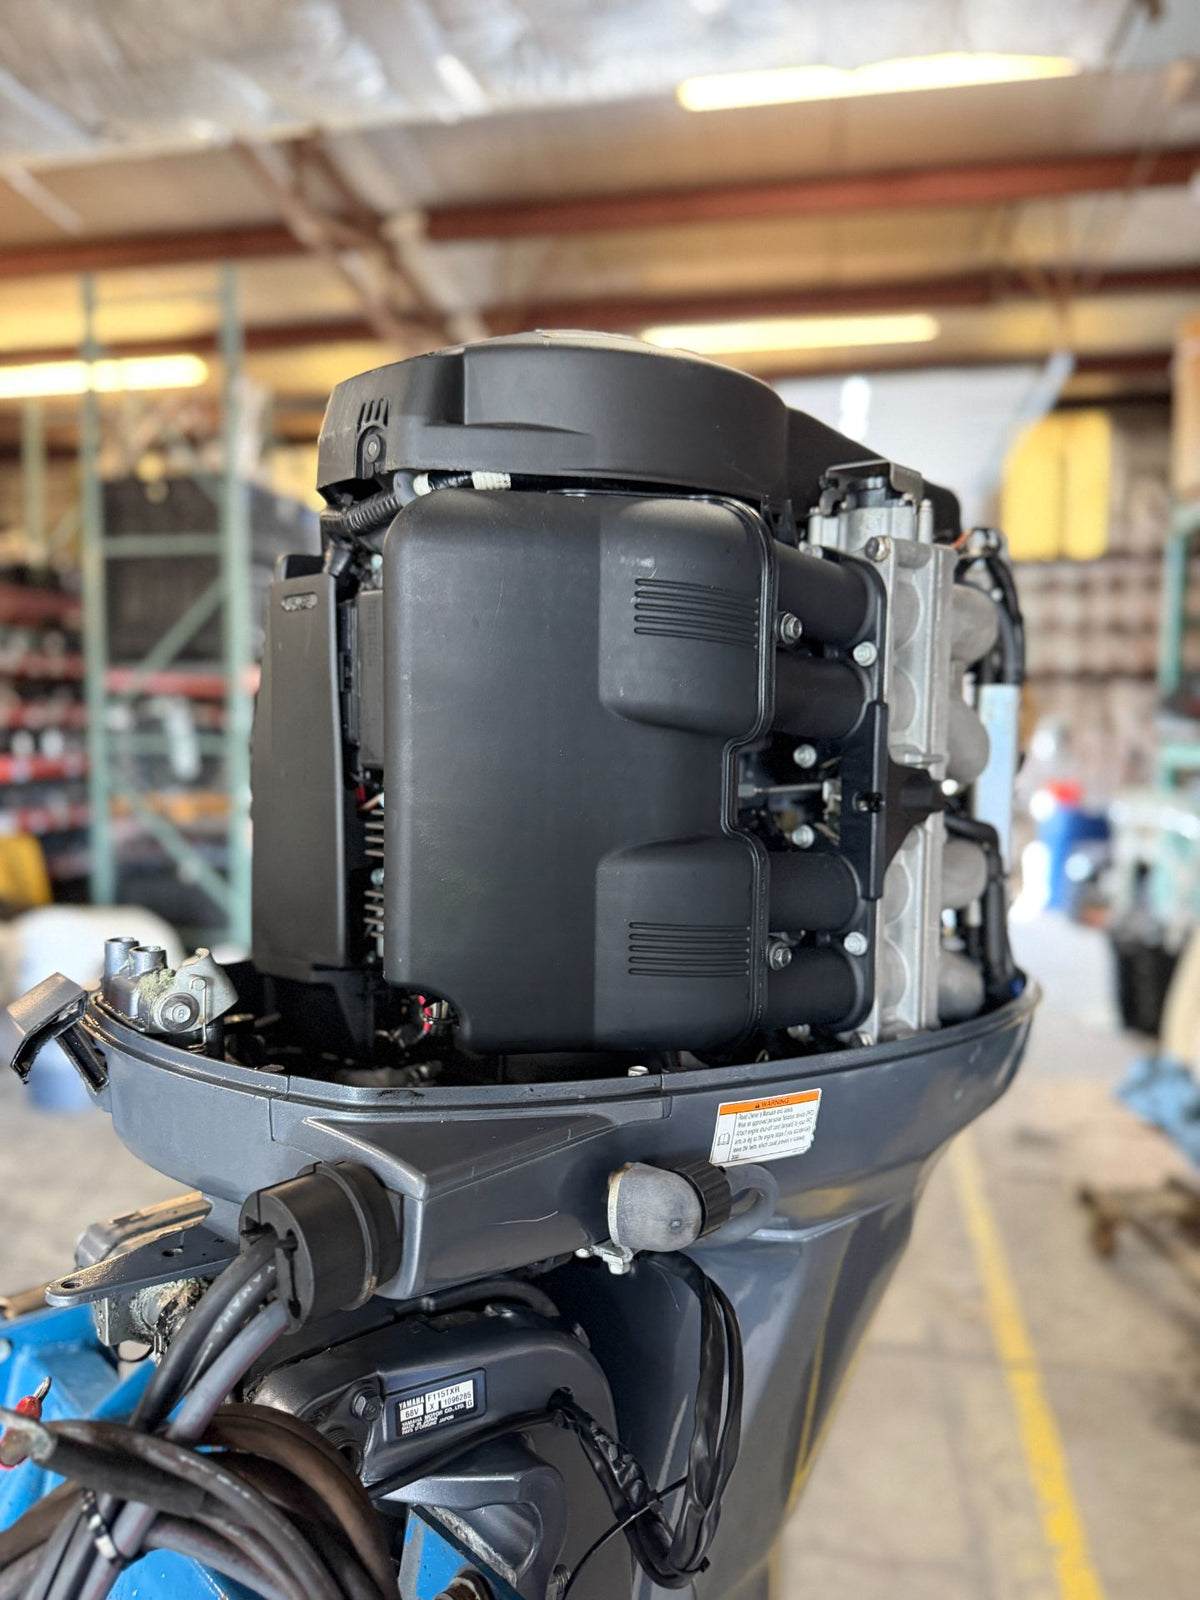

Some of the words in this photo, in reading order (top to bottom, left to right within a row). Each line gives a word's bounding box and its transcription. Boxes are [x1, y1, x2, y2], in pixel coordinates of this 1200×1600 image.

[761, 1097, 789, 1107] WARNING
[427, 1385, 460, 1402] F115TXR
[444, 1391, 472, 1406] 1096285
[399, 1395, 425, 1410] YAMAHA
[430, 1402, 435, 1410] X
[405, 1407, 419, 1418] 68V
